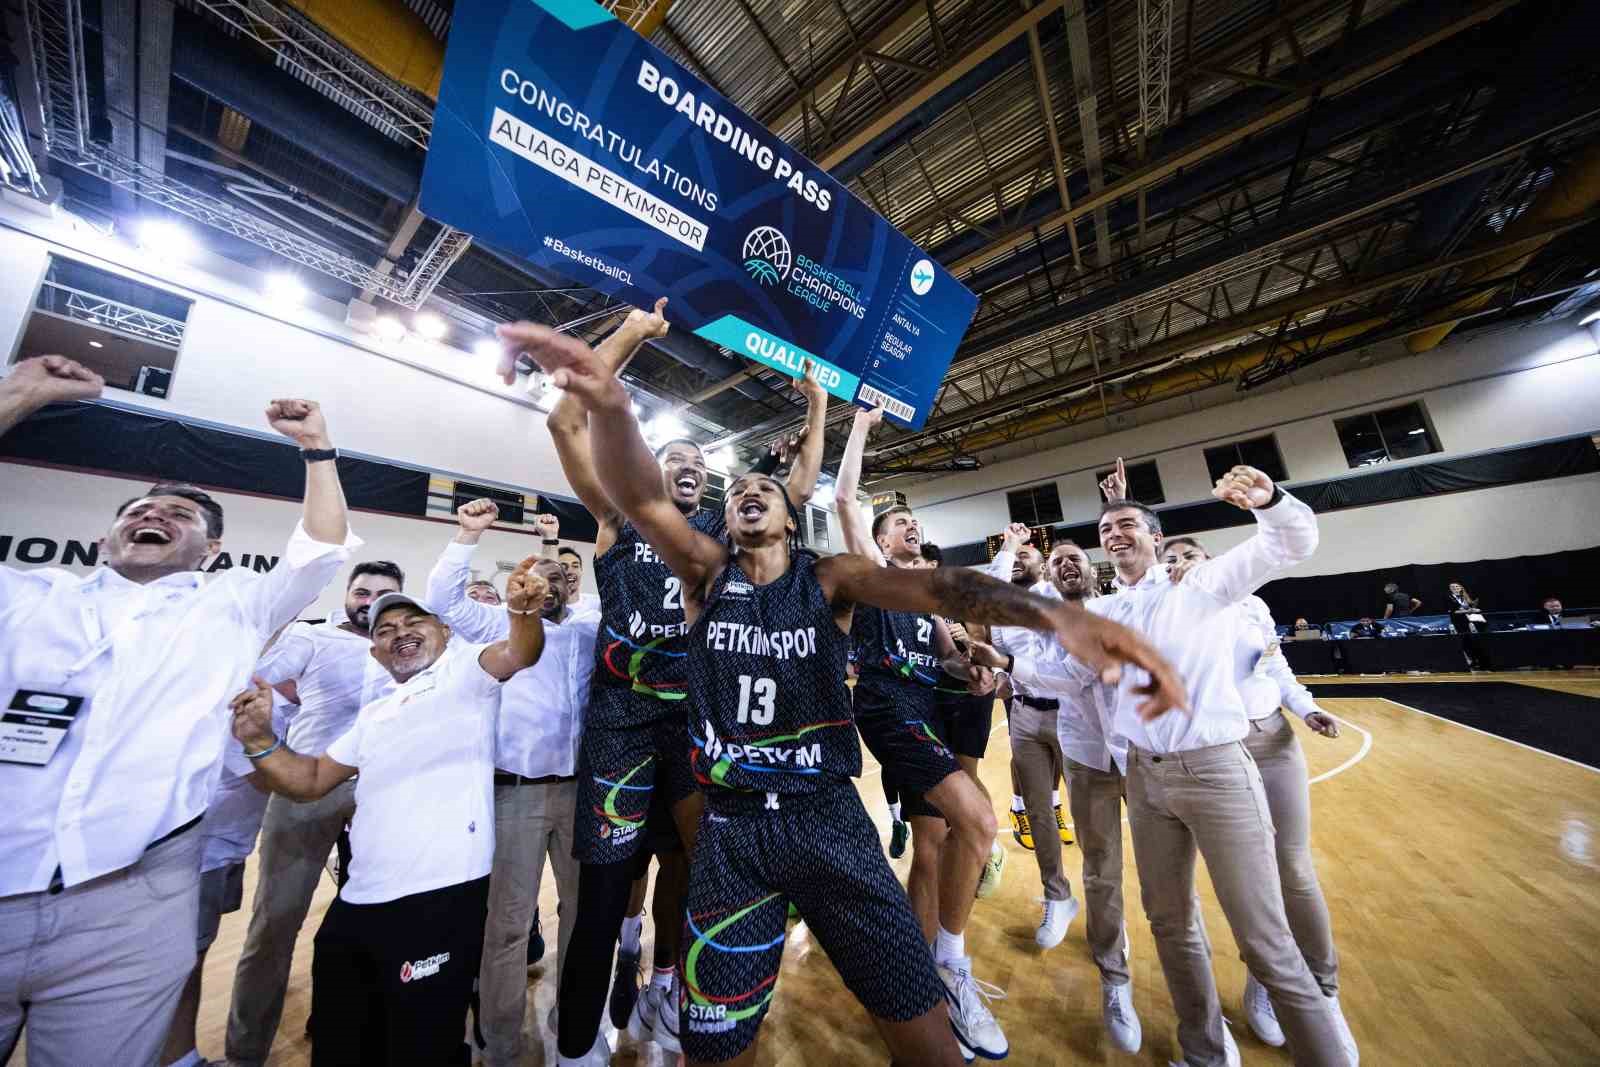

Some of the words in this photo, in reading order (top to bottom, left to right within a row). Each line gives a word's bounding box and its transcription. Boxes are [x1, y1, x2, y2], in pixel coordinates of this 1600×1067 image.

[501, 69, 718, 212] CONGRATULATIONS
[637, 60, 773, 170] BOARDING
[774, 158, 831, 211] PASS
[497, 119, 580, 177] ALIAGA
[586, 167, 703, 245] PETKIMSPOR
[543, 235, 634, 286] #BasketballCL
[796, 255, 862, 303] BASKETBALL
[787, 281, 833, 313] LEAGUE
[791, 267, 867, 320] CHAMPIONS
[892, 313, 920, 337] ANTALYA
[881, 341, 906, 361] SEASON
[737, 675, 777, 726] 13
[689, 1003, 727, 1020] STAR
